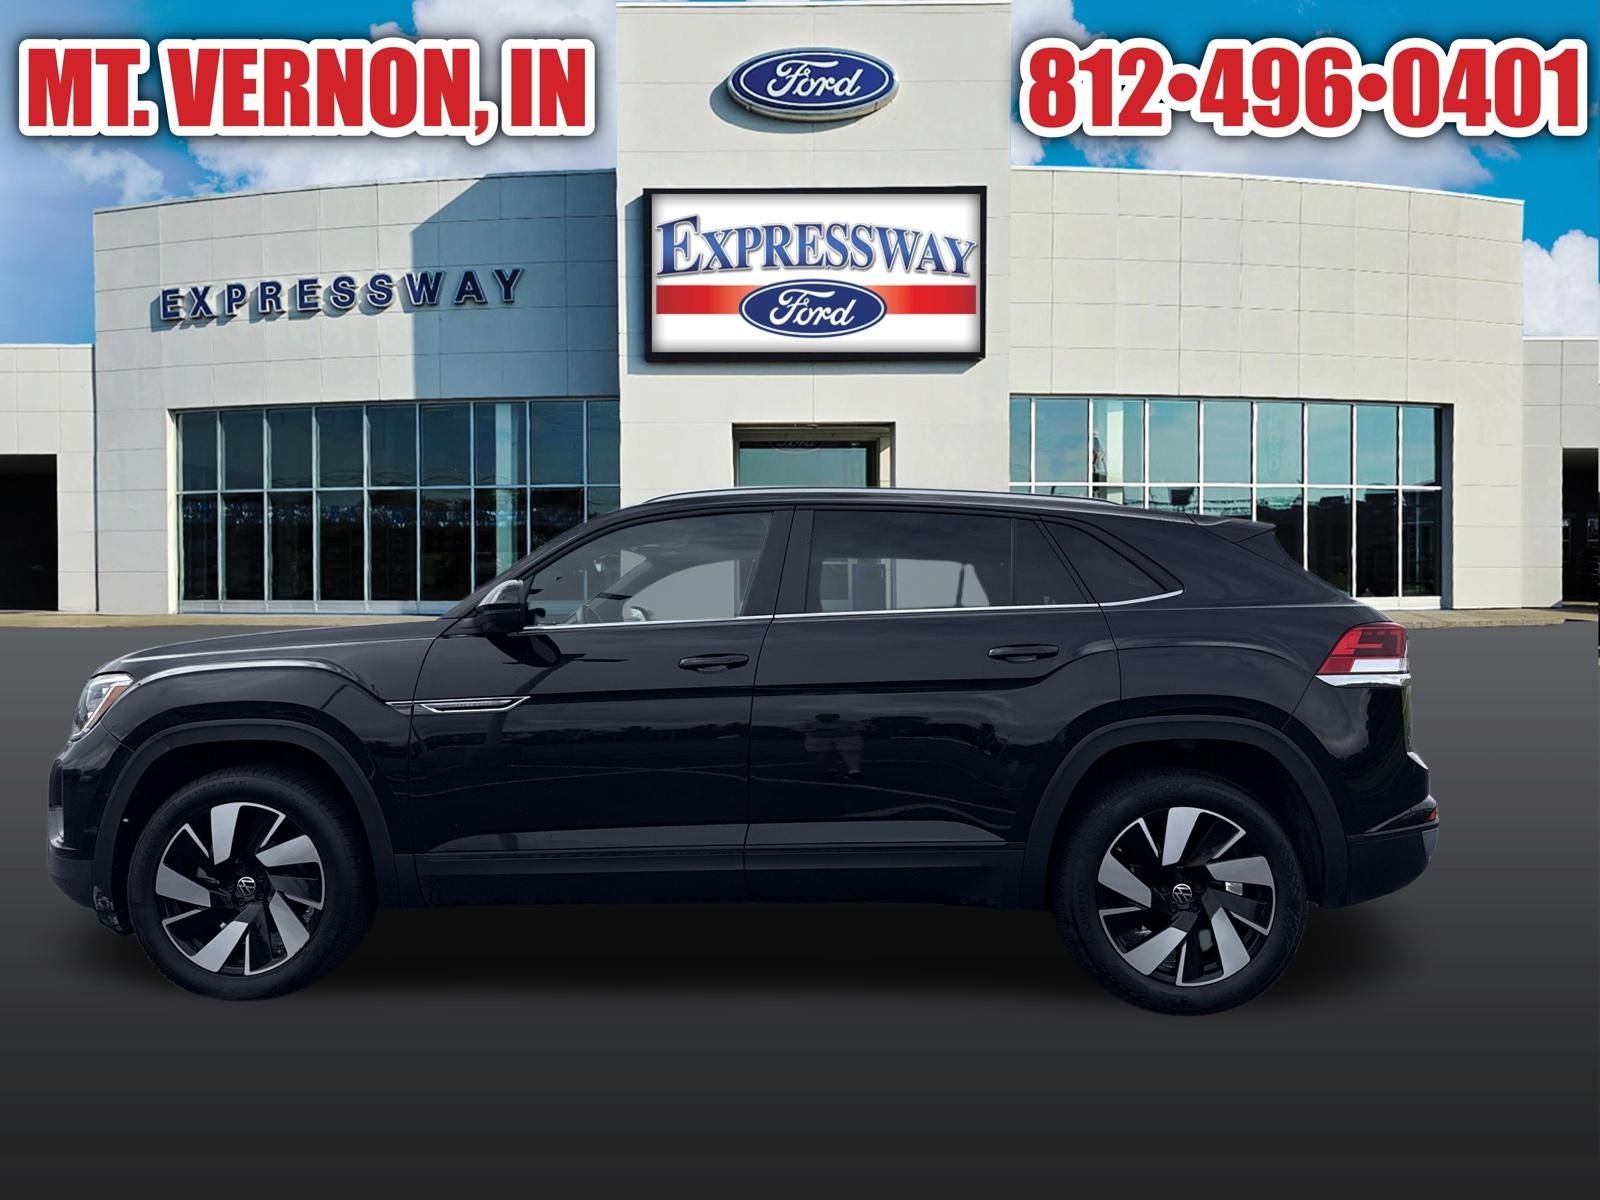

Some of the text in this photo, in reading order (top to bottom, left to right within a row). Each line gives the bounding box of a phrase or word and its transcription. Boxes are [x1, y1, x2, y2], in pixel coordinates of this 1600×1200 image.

[767, 59, 864, 98] Ford
[656, 214, 978, 278] EXPRESSWAY
[159, 267, 525, 322] EXPRESSWAY
[769, 288, 857, 326] Ford
